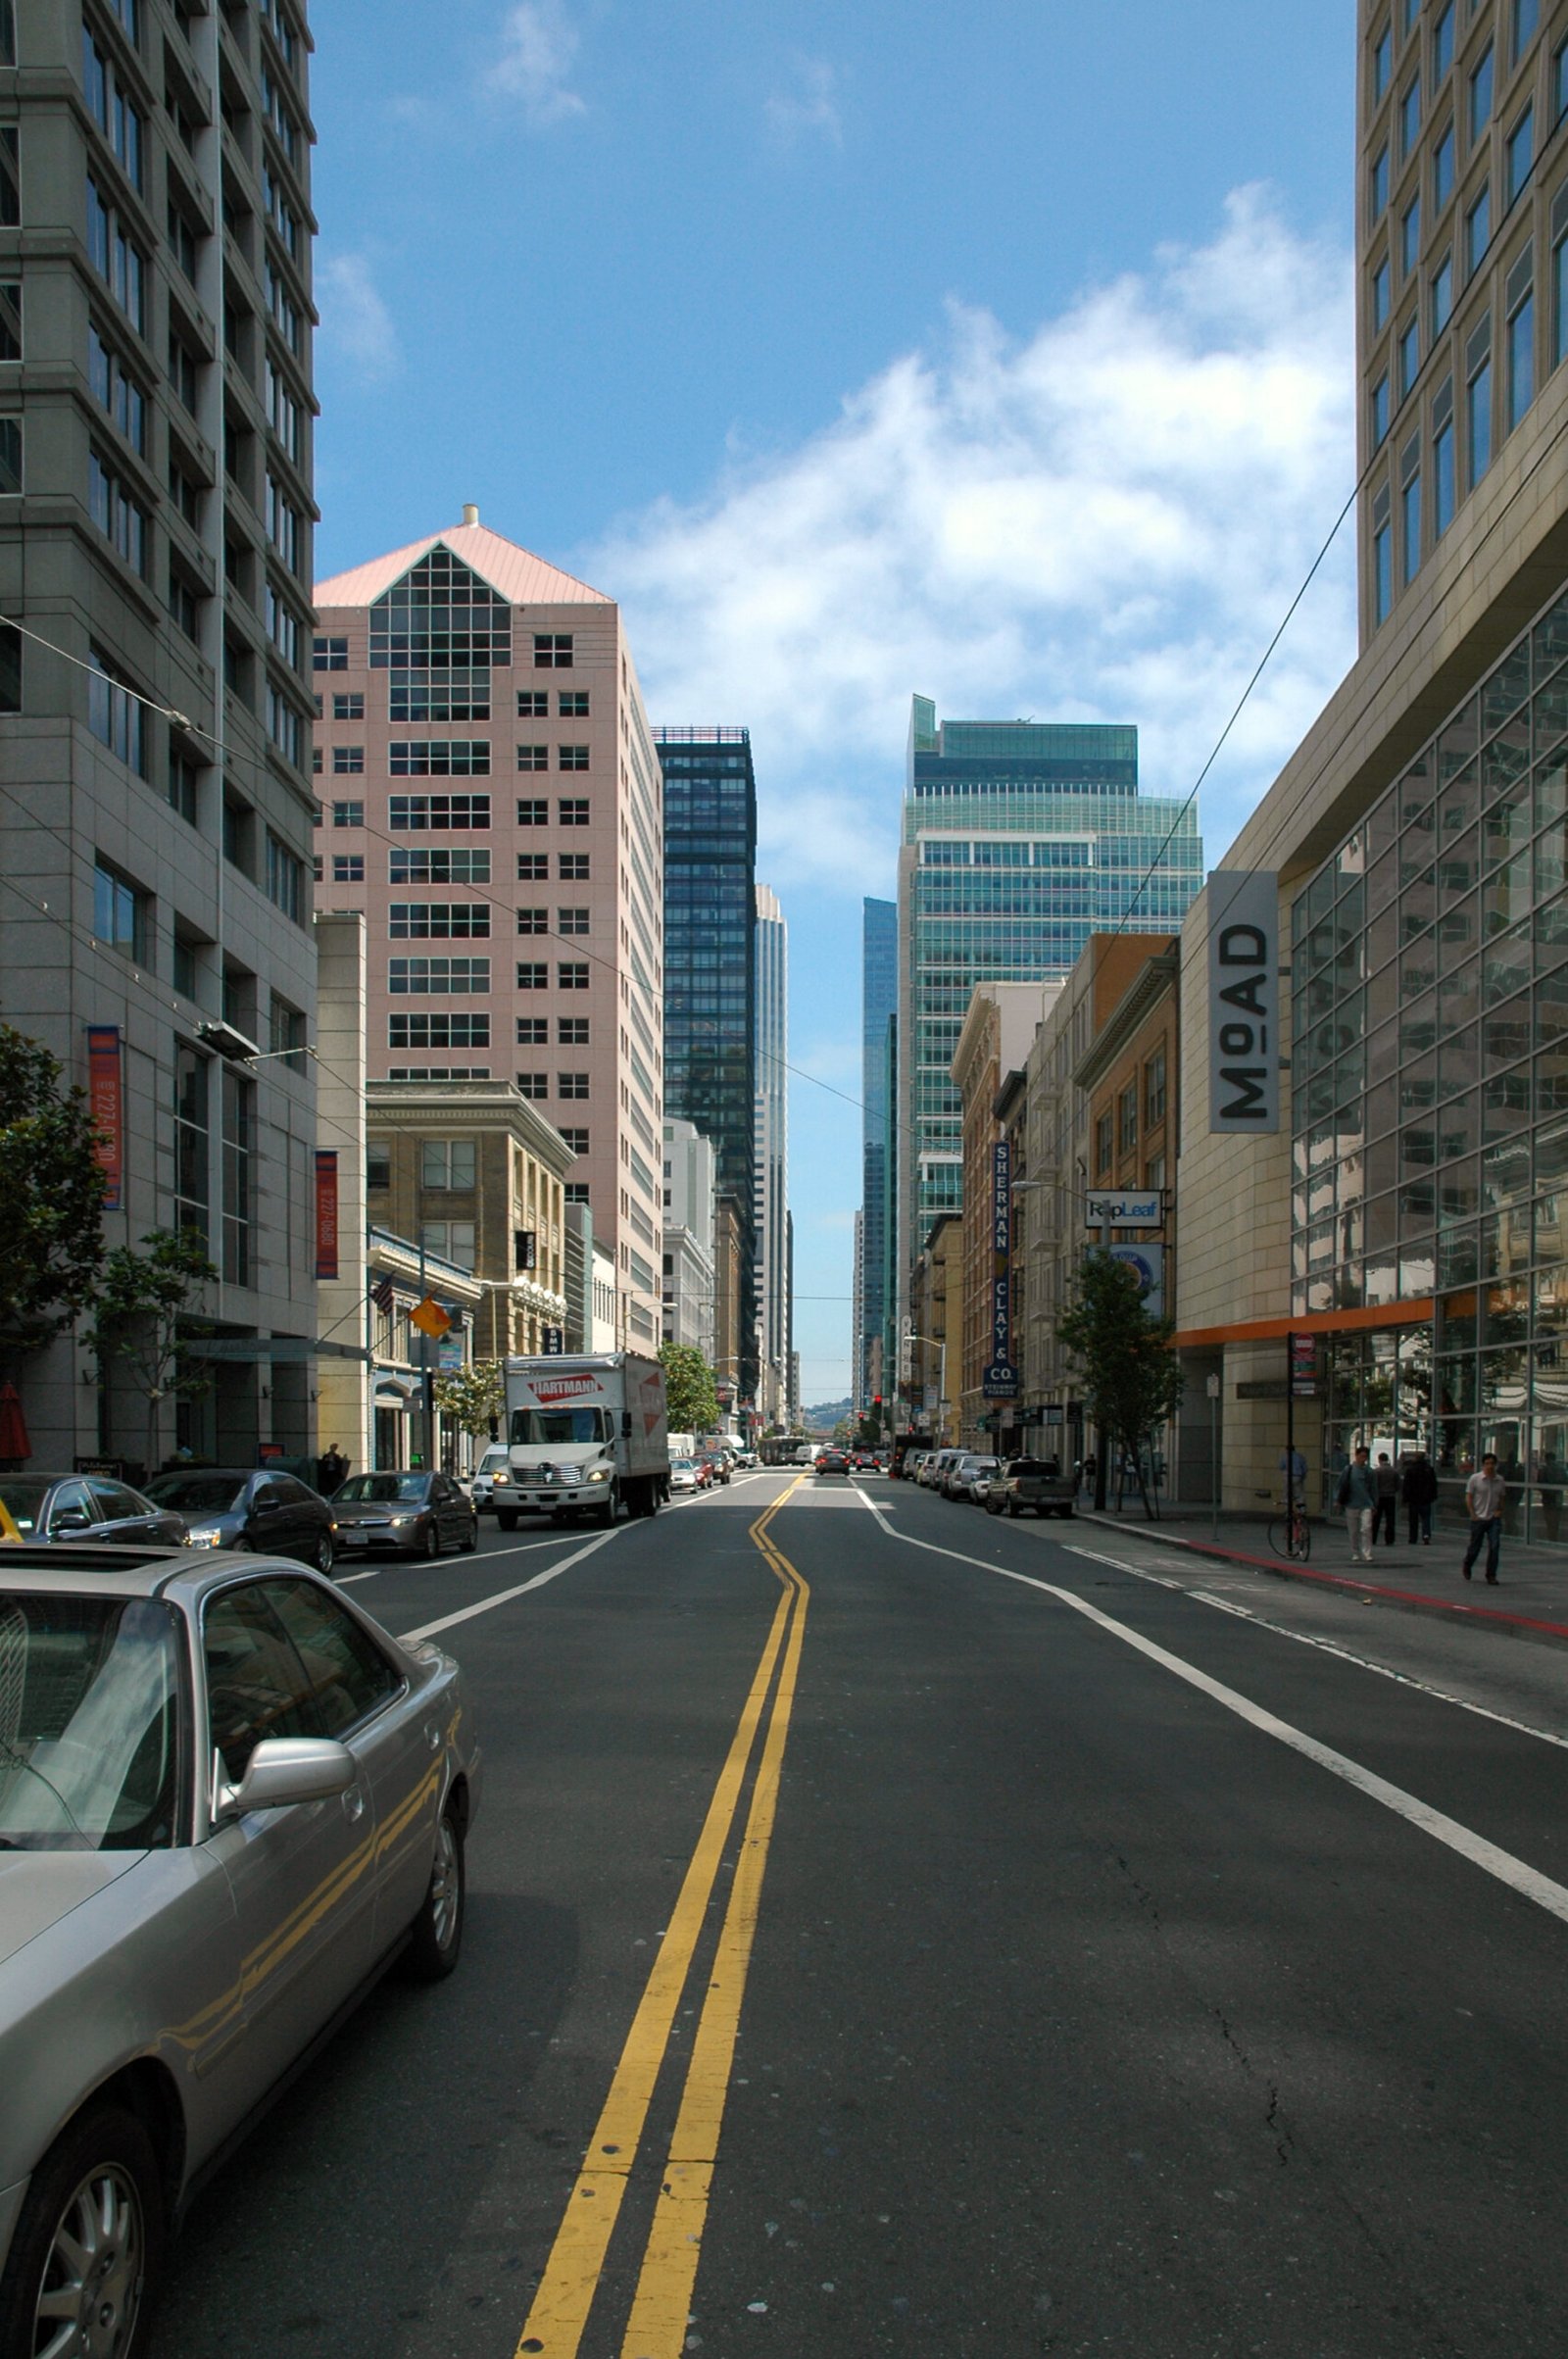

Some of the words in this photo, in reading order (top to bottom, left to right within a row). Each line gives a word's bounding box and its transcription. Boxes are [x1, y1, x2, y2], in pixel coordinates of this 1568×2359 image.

[997, 1146, 1007, 1249] SHERMAN
[1090, 1202, 1156, 1220] RpLeaf
[996, 1283, 1007, 1340] CLAY
[996, 1347, 1006, 1359] &
[533, 1380, 597, 1395] HARTMANN
